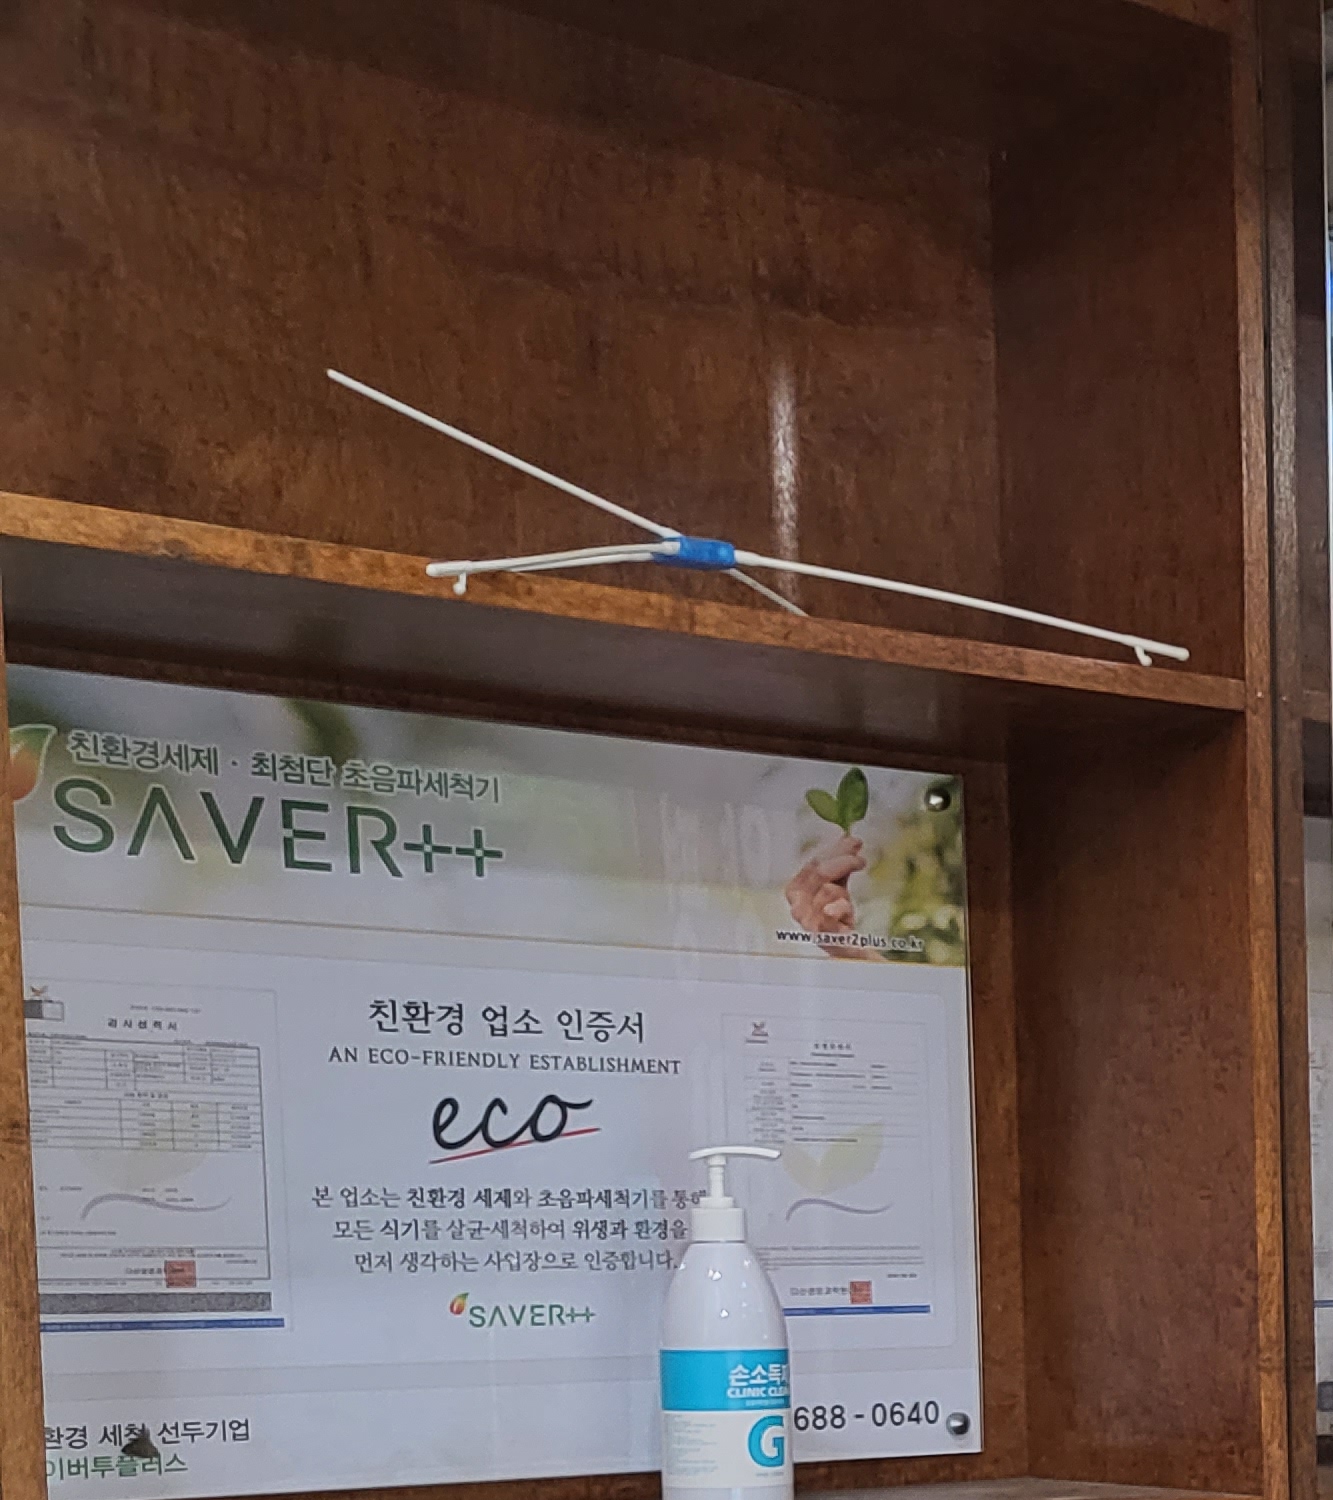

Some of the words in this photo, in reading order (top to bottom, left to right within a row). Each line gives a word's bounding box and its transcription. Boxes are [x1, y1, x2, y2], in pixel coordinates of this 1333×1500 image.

[68, 732, 219, 776] 친환경세제
[252, 750, 334, 788] 최첨단
[343, 761, 500, 803] 초음파세척기
[369, 999, 465, 1037] 친환경
[482, 1004, 544, 1038] 업소
[557, 1008, 645, 1044] 인증서
[329, 1046, 358, 1063] AN
[368, 1048, 520, 1070] ECO-FRIENDLY
[529, 1054, 682, 1075] ESTABLISHMENT
[432, 1094, 594, 1151] eco
[312, 1186, 334, 1208] 본
[340, 1186, 401, 1208] 업소는
[407, 1186, 466, 1209] 친환경
[473, 1187, 532, 1209] 세제와
[537, 1188, 668, 1210] 초음파세척기를
[332, 1219, 375, 1241] 모든
[380, 1218, 441, 1241] 식기를
[572, 1218, 629, 1240] 위생과
[633, 1218, 688, 1240] 환경을
[354, 1251, 393, 1274] 먼저
[400, 1251, 479, 1274] 생각하는
[483, 1250, 579, 1272] 사업장으로
[157, 1418, 250, 1446] 선두기업
